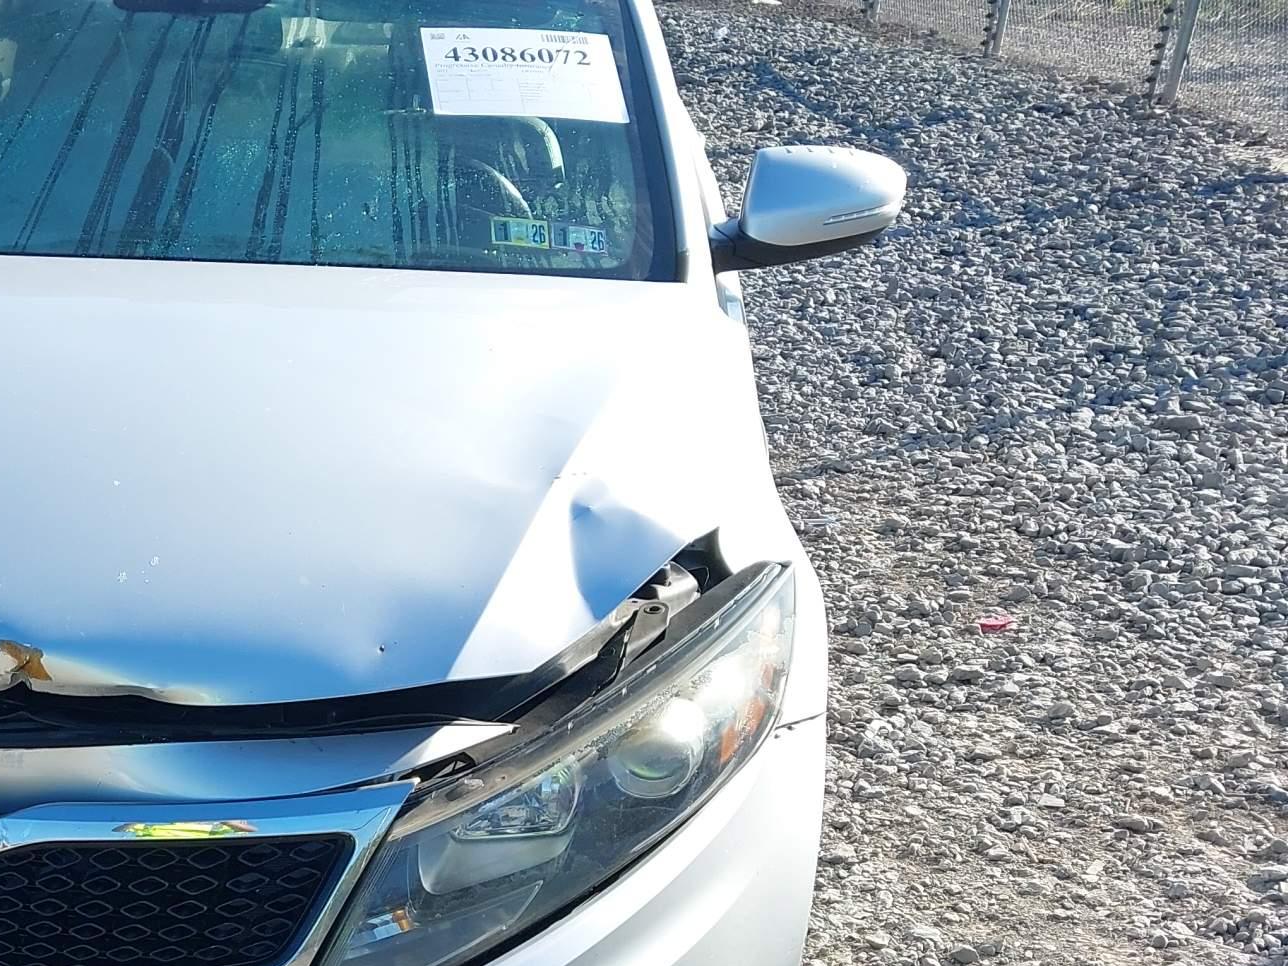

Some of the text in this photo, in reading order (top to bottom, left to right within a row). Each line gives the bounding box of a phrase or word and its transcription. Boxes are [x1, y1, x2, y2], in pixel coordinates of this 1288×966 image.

[444, 46, 592, 66] 43086072
[531, 223, 547, 244] 26
[590, 230, 605, 251] 26
